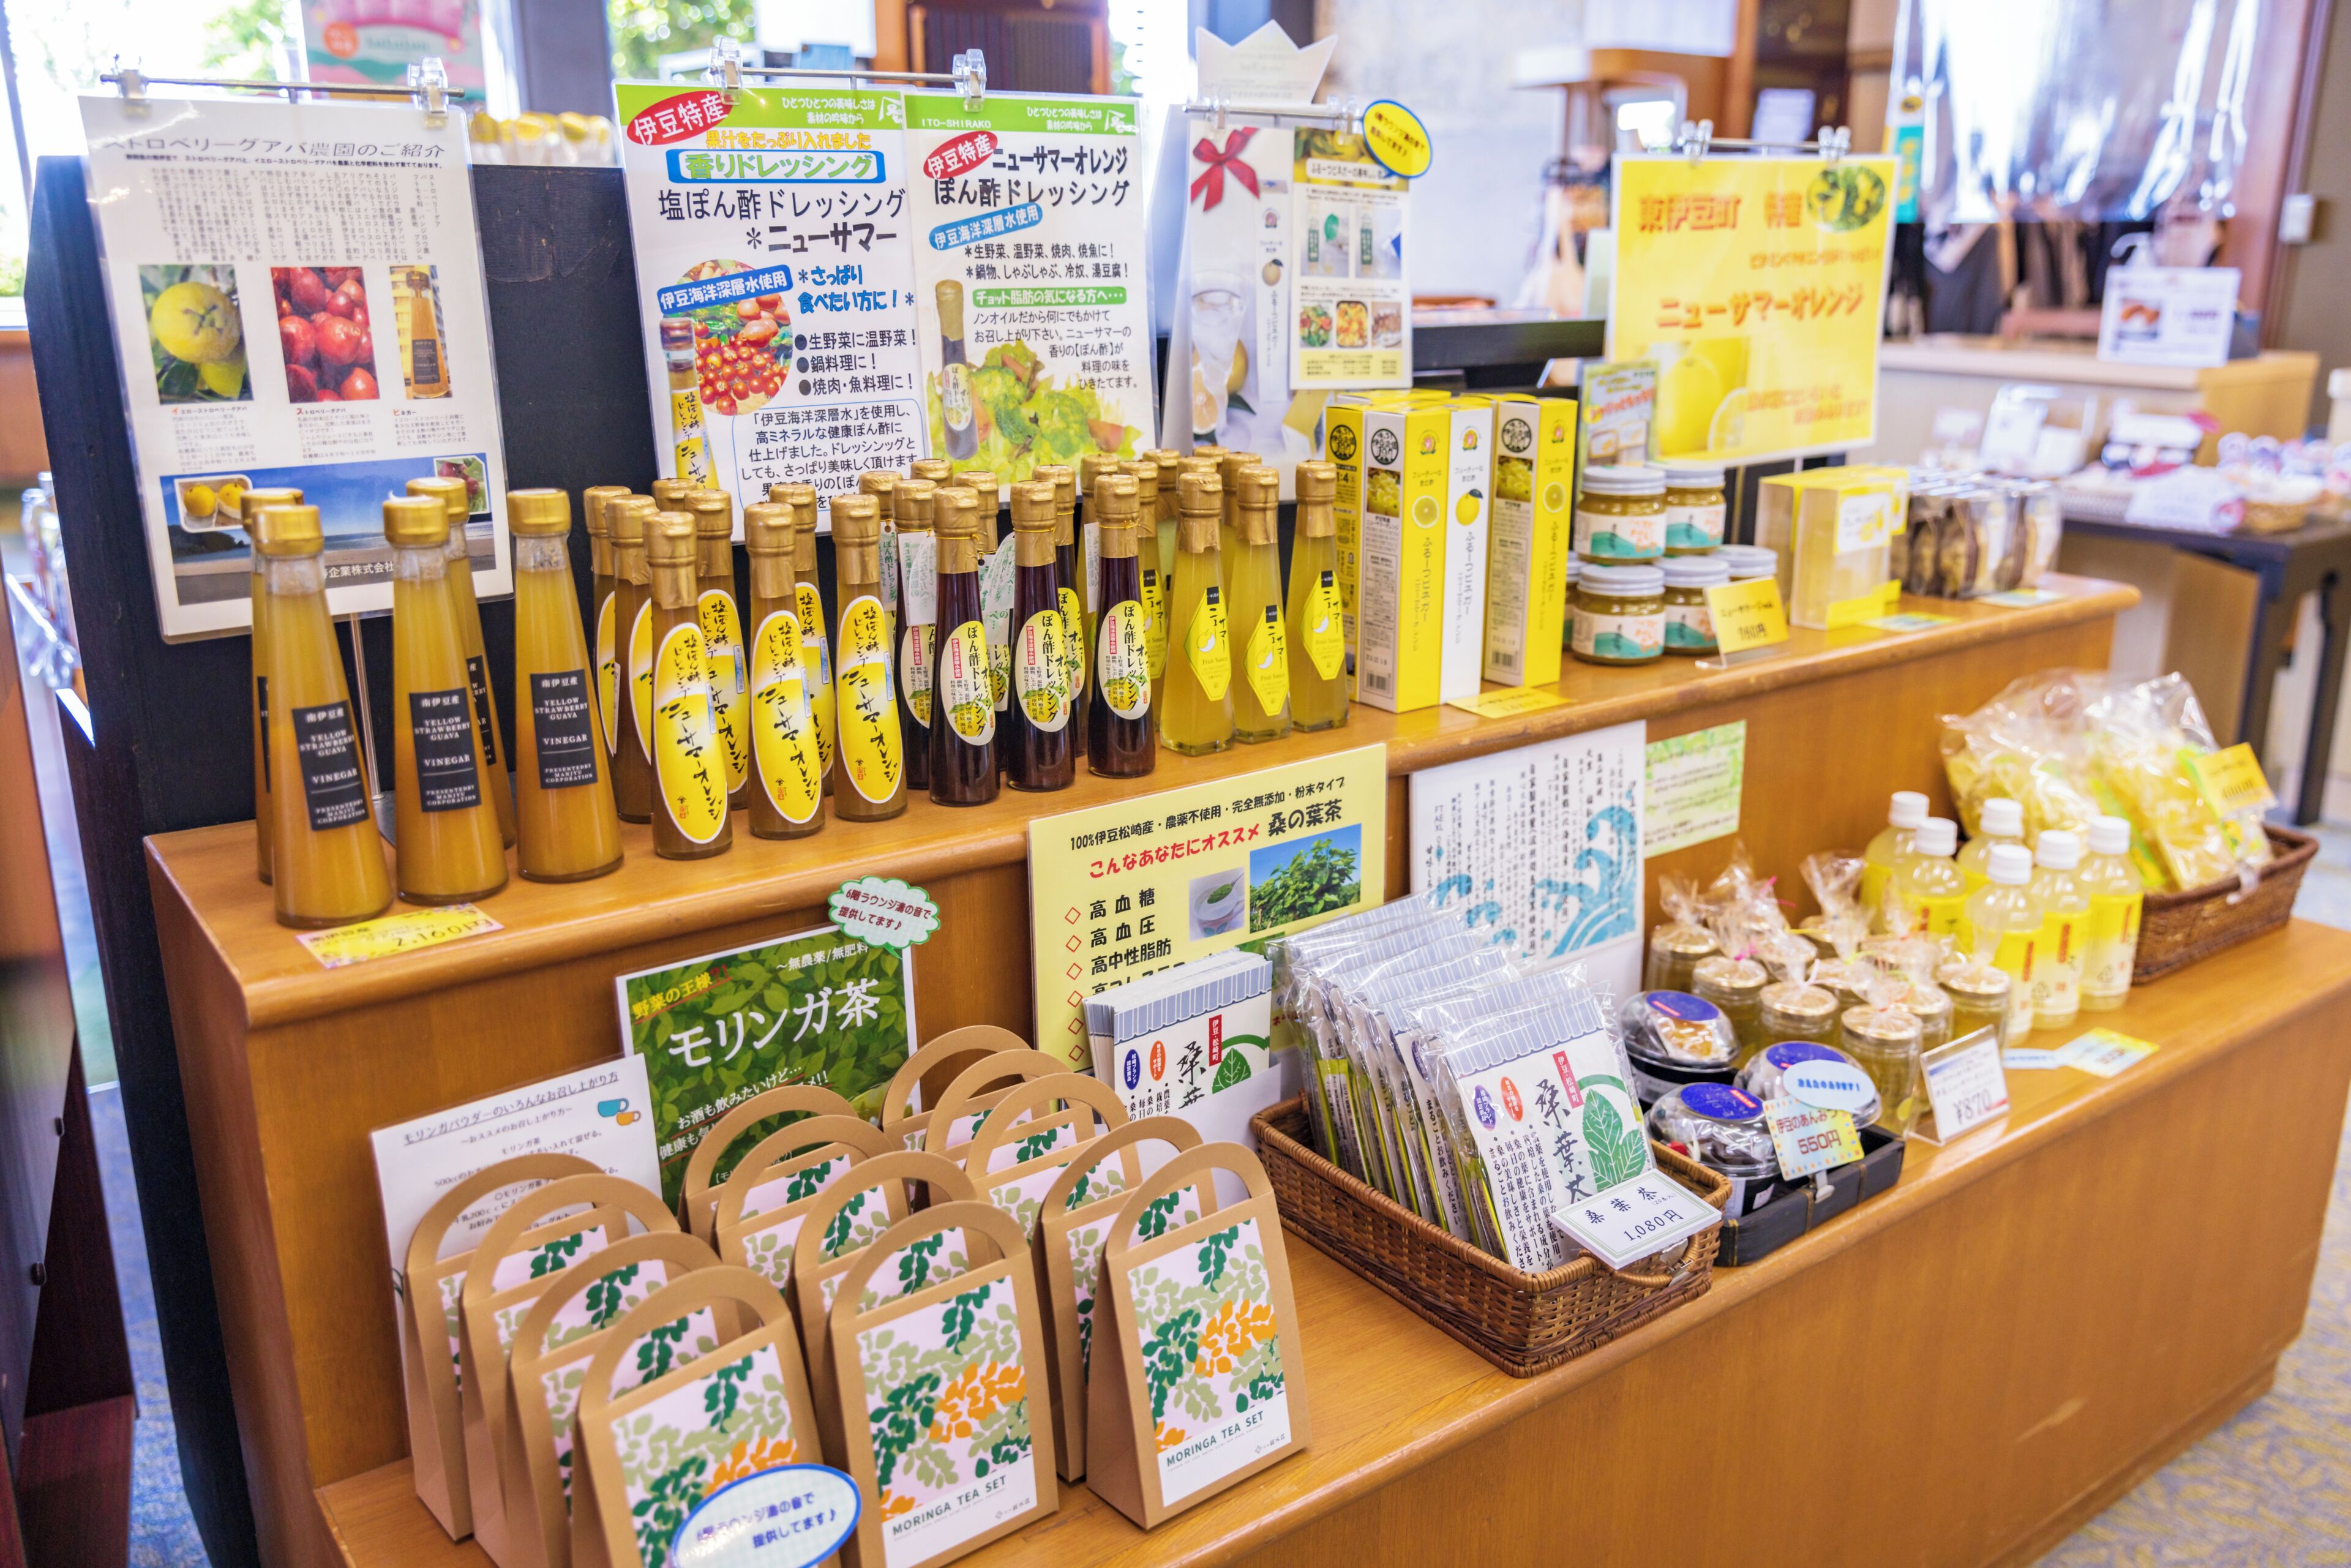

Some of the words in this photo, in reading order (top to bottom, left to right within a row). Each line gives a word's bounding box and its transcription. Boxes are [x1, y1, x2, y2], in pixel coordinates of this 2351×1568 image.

[782, 97, 876, 111] ひとつひとつの美味しさは
[1027, 107, 1102, 120] ひとつひとつの美味しさは
[632, 93, 729, 146] 伊豆特産
[806, 113, 864, 125] 素材の吟味から
[706, 131, 871, 150] 果汁をたっぷり入れました
[685, 153, 872, 179] 香りドレッシング
[928, 133, 994, 178] 伊豆特産
[992, 146, 1127, 174] ニューサマーオレンジ
[658, 189, 906, 220] 塩ぽん酢ドレッシング
[934, 177, 1130, 207] ぽん酢ドレッシング
[934, 204, 1039, 249] 伊豆海洋深層水使用
[661, 271, 787, 309] 伊豆海洋深層水使用
[973, 310, 1111, 325] ノンオイルだから何にでもかけて
[1656, 282, 1862, 329] ニューサマーオレンジ
[1081, 359, 1130, 373] 料理の味を
[1079, 377, 1138, 390] ひきたてます。
[711, 600, 729, 646] 塩ぽん酢
[800, 592, 815, 637] 塩ぽん酢
[863, 606, 880, 653] 塩ぽん酢
[778, 621, 797, 668] 塩ぽん酢
[1124, 604, 1138, 711] ぽん酢ドレッシング
[684, 634, 700, 683] 塩ぽん酢
[1042, 614, 1058, 724] ぽん酢ドレッシング
[541, 676, 579, 688] 南伊豆産
[967, 625, 986, 737] ぽん酢ドレッシング
[421, 695, 460, 708] 南伊豆産
[534, 702, 588, 715] STRAWBERRY
[544, 697, 580, 707] YELLOW
[306, 707, 345, 724] 南伊豆産
[414, 722, 471, 735] STRAWBERRY
[424, 716, 462, 727] YELLOW
[550, 712, 577, 721] GUAVA
[311, 730, 347, 743] YELLOW
[430, 732, 460, 741] GUAVA
[543, 733, 588, 746] VINEGAR
[318, 746, 347, 757] GUAVA
[424, 754, 471, 767] VINEGAR
[312, 768, 358, 784] VINEGAR
[546, 772, 593, 783] CORPORATION
[427, 795, 476, 806] CORPORATION
[317, 809, 366, 824] CORPORATION
[1089, 823, 1261, 879] こんなあなたにオススメ
[1268, 799, 1343, 837] 桑の葉茶
[846, 889, 931, 919] 6階ラウンジ濤の音で
[1091, 938, 1172, 976] 高中性脂肪
[669, 978, 881, 1067] モリンガ茶
[404, 1071, 619, 1146] モリンガパウダーのいろんなお召し上がり方
[501, 1137, 541, 1155] モリンガ茶
[1798, 1130, 1842, 1155] 550円
[1496, 1145, 1533, 1266] 桑の美味しさと栄養を
[1513, 1138, 1553, 1271] 桑の葉に含まれる成分が
[1623, 1209, 1684, 1242] 1,080円
[1166, 1436, 1217, 1467] MORINGA
[1221, 1423, 1241, 1439] TEA
[1245, 1410, 1264, 1428] SET
[893, 1502, 952, 1536] MORINGA
[957, 1488, 980, 1506] TEA
[986, 1474, 1007, 1493] SET
